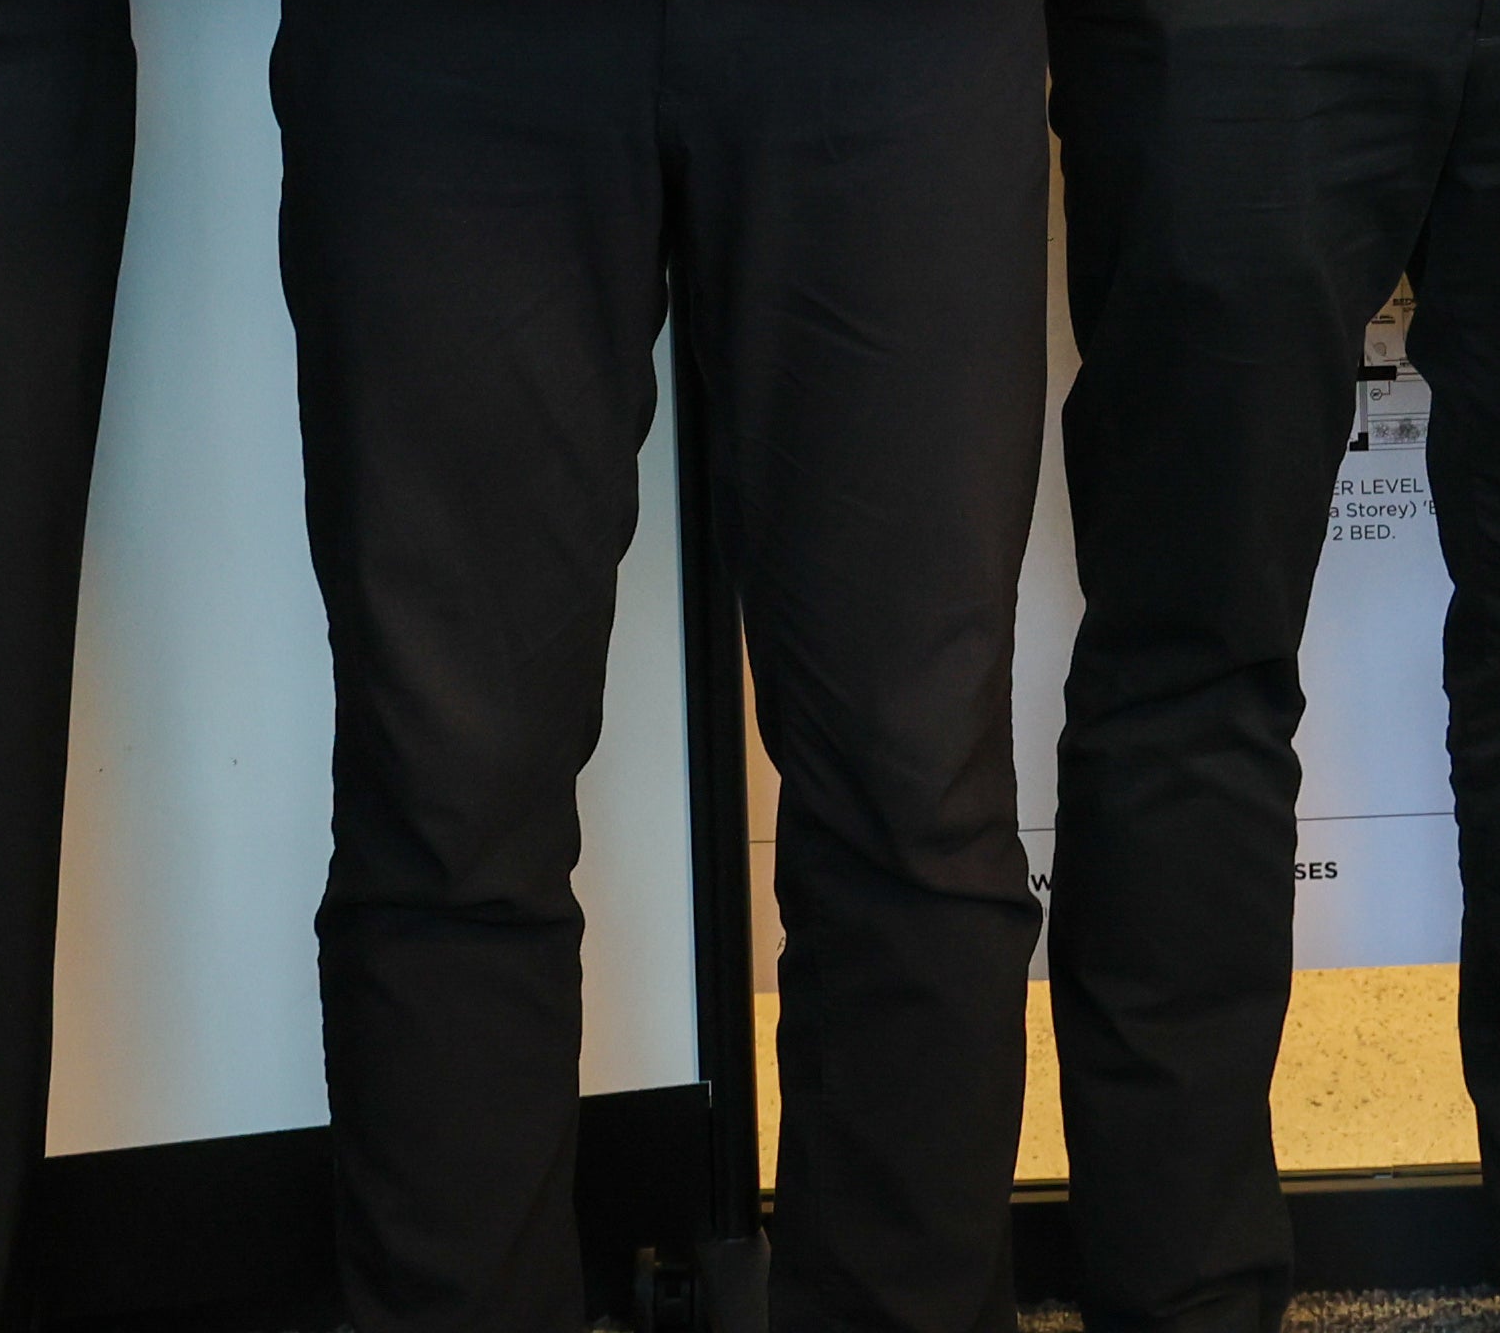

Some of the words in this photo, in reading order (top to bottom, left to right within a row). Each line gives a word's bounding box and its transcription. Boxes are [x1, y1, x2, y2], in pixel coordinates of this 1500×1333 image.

[1360, 478, 1424, 495] LEVEL
[1346, 501, 1417, 520] Storey)
[1332, 526, 1343, 541] 2
[1349, 524, 1397, 542] BED.
